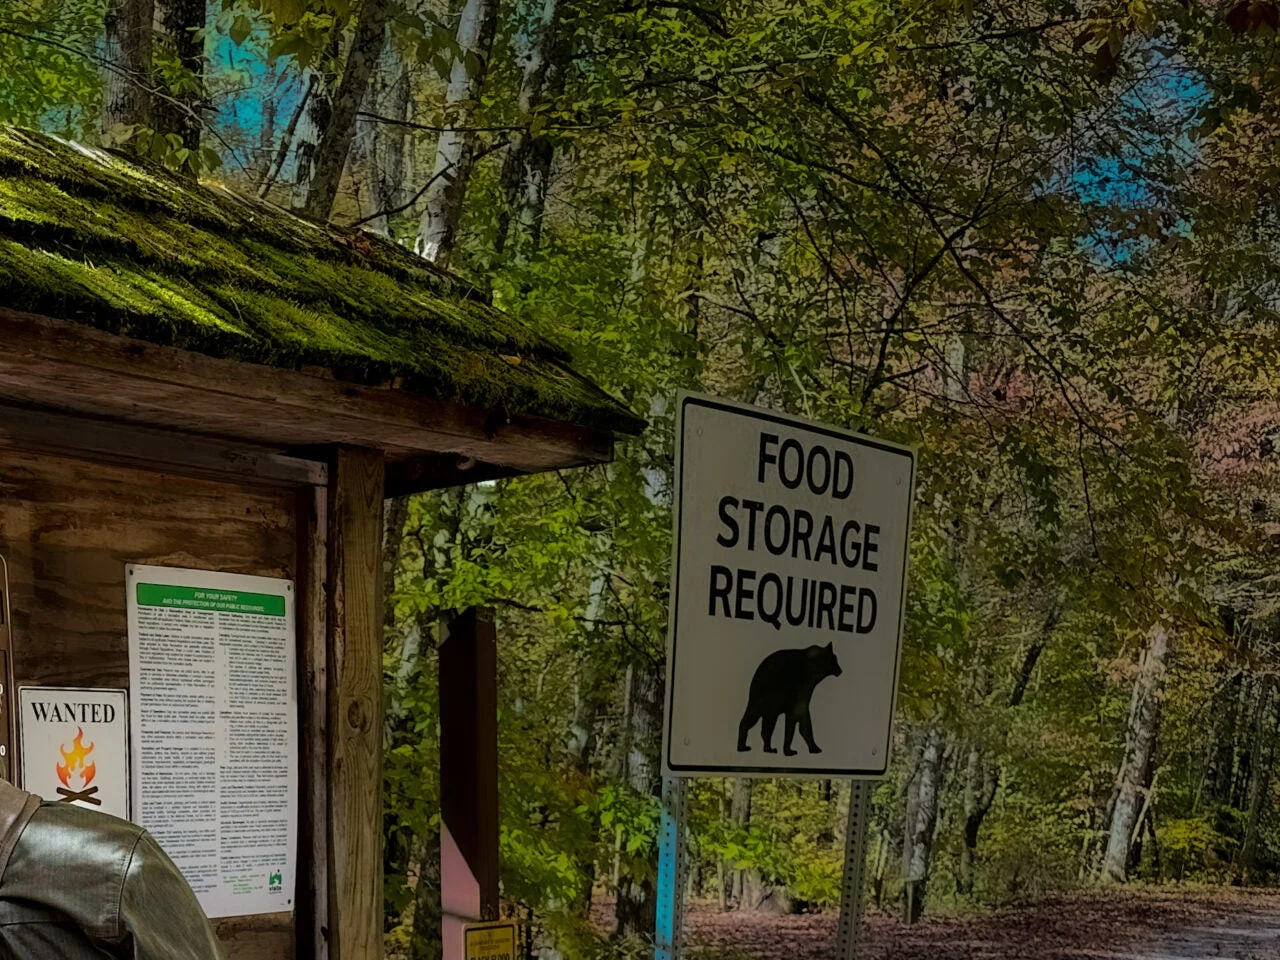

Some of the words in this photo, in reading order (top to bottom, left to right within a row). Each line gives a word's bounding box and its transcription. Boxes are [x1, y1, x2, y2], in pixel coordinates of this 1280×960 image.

[758, 432, 854, 500] FOOD
[716, 496, 881, 572] STORAGE
[708, 565, 877, 635] REQUIRED
[31, 702, 116, 725] WANTED
